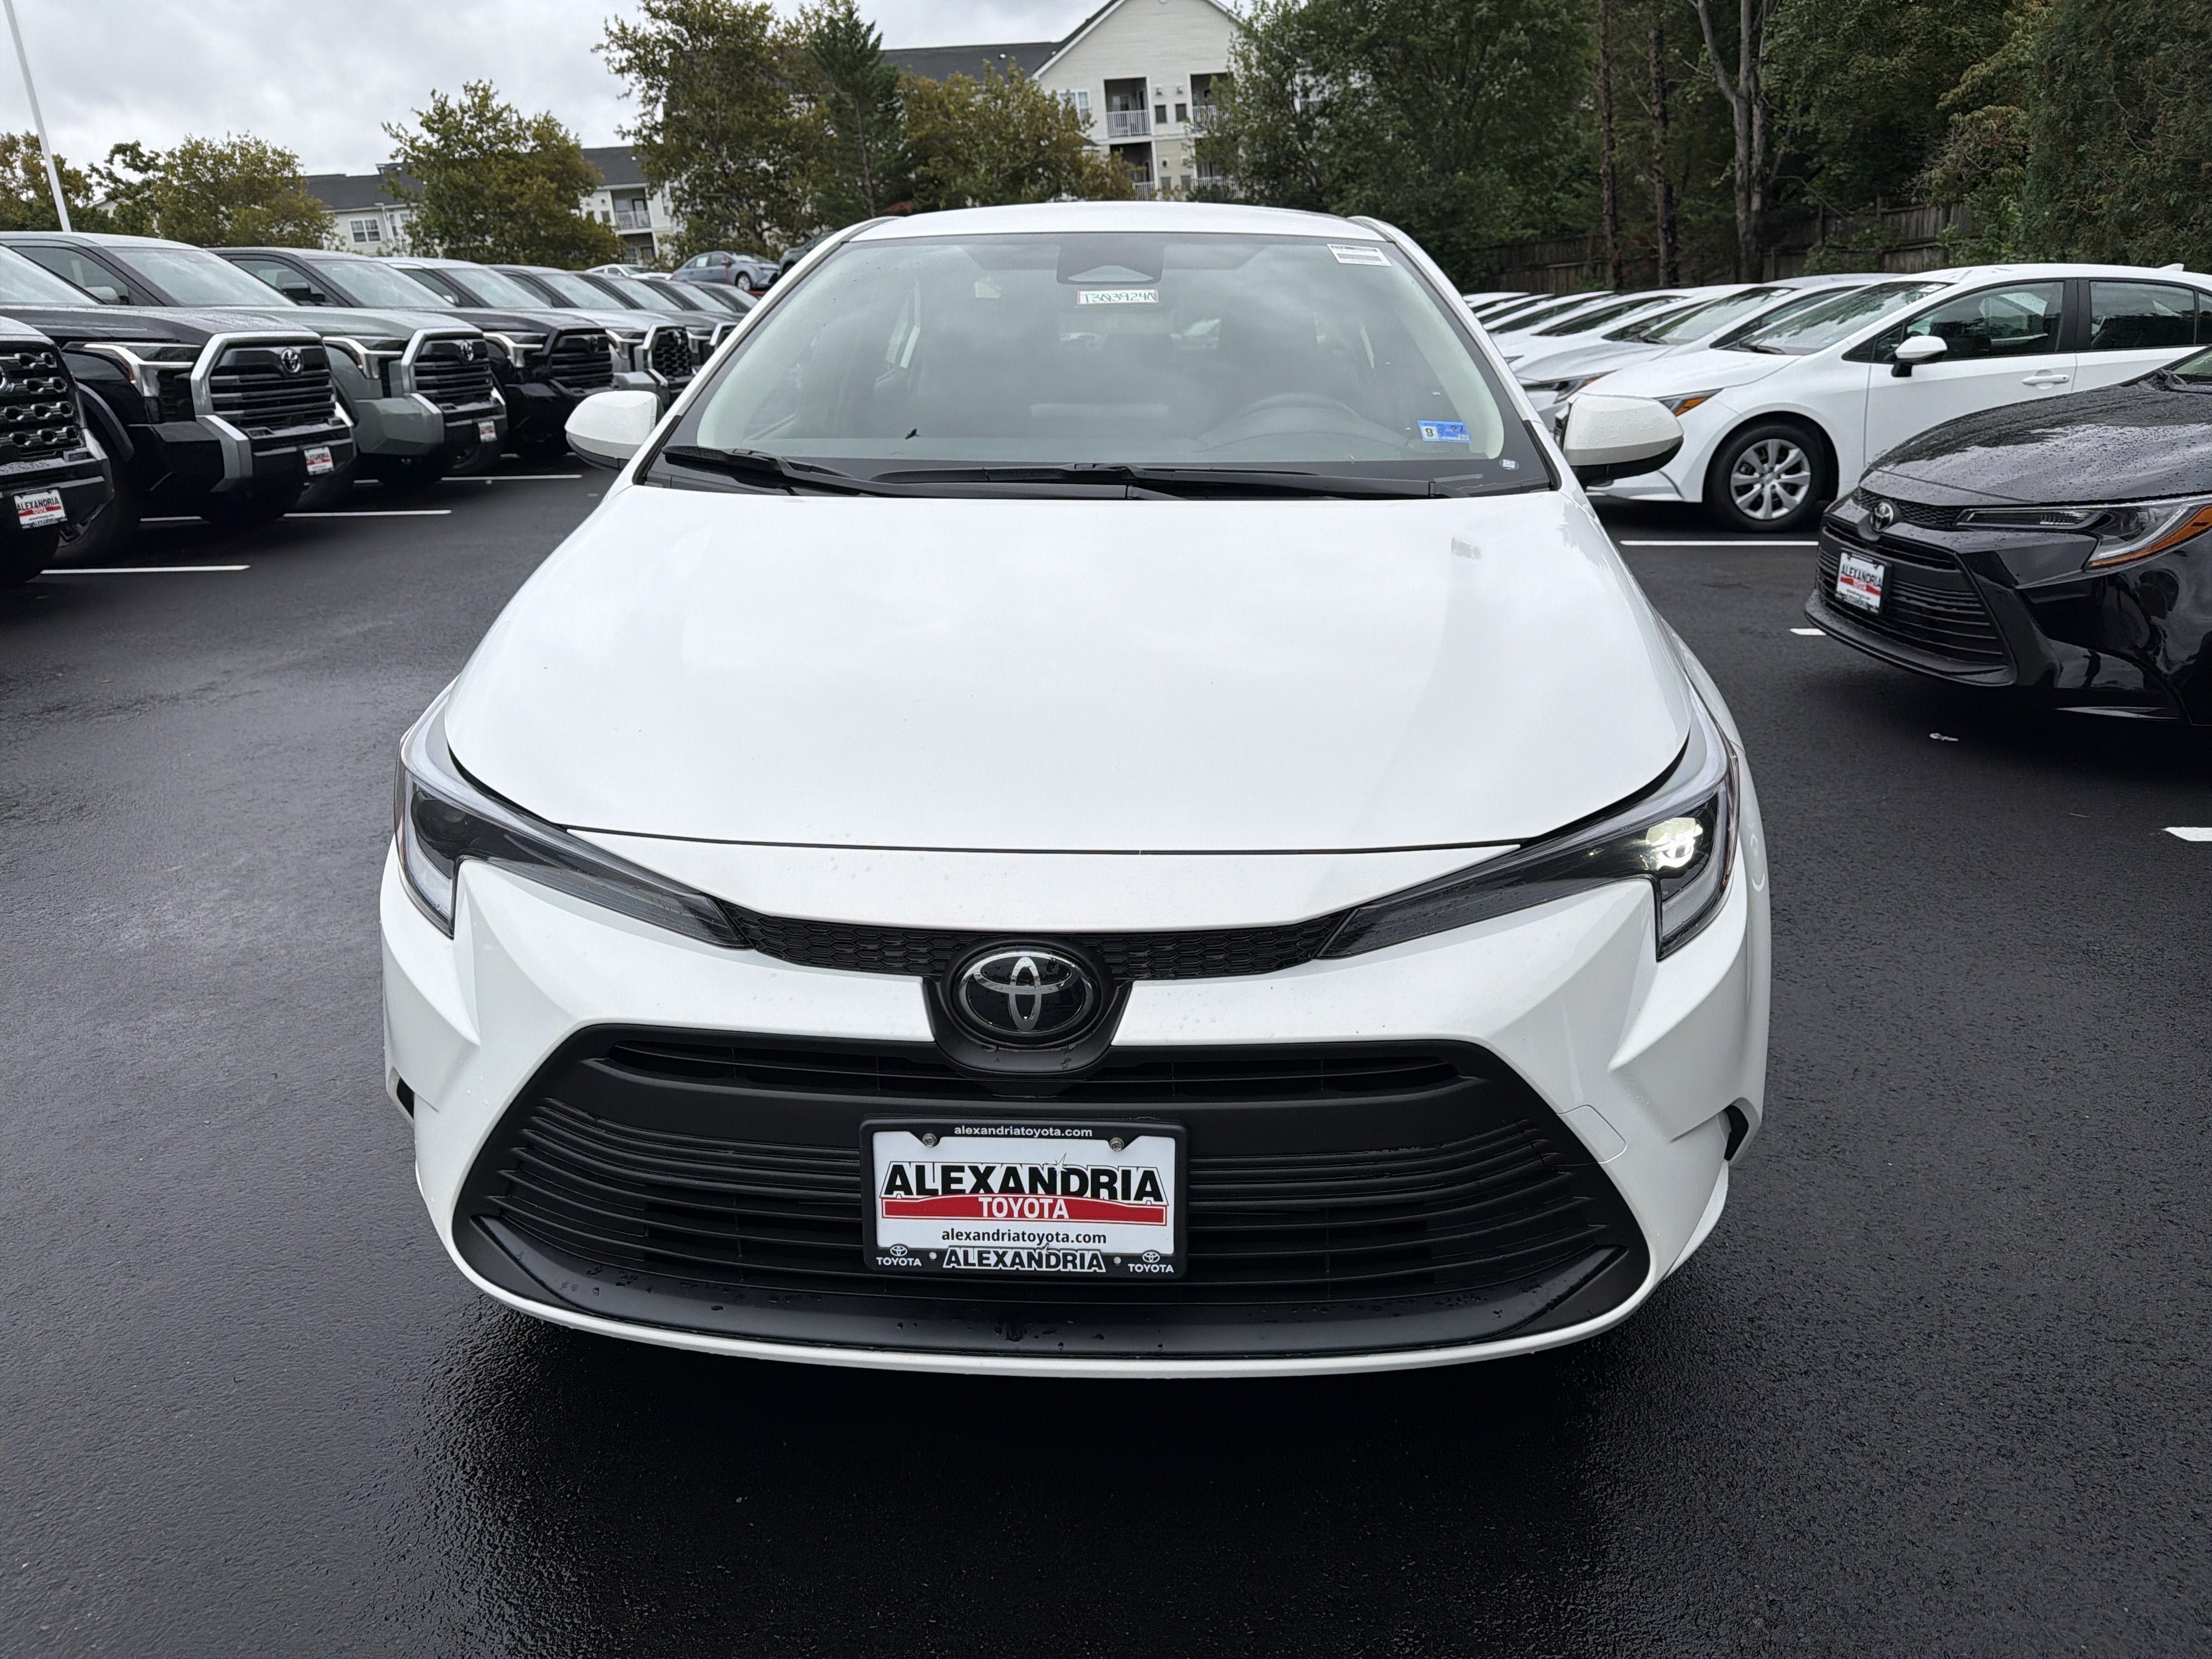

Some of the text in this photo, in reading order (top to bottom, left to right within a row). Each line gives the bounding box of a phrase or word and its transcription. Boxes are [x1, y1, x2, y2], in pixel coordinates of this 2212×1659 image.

[1425, 428, 1434, 437] 9
[17, 496, 60, 511] ALEXANDRIA
[953, 1125, 1093, 1138] alexandriatoyota.com
[883, 1164, 1164, 1203] ALEXANDRIA
[978, 1197, 1070, 1220] TOYOTA
[941, 1228, 1107, 1245] alexandriatoyota.com
[876, 1257, 922, 1267] TOYOTA
[943, 1246, 1106, 1273] ALEXANDRIA
[1127, 1263, 1175, 1273] TOYOTA
